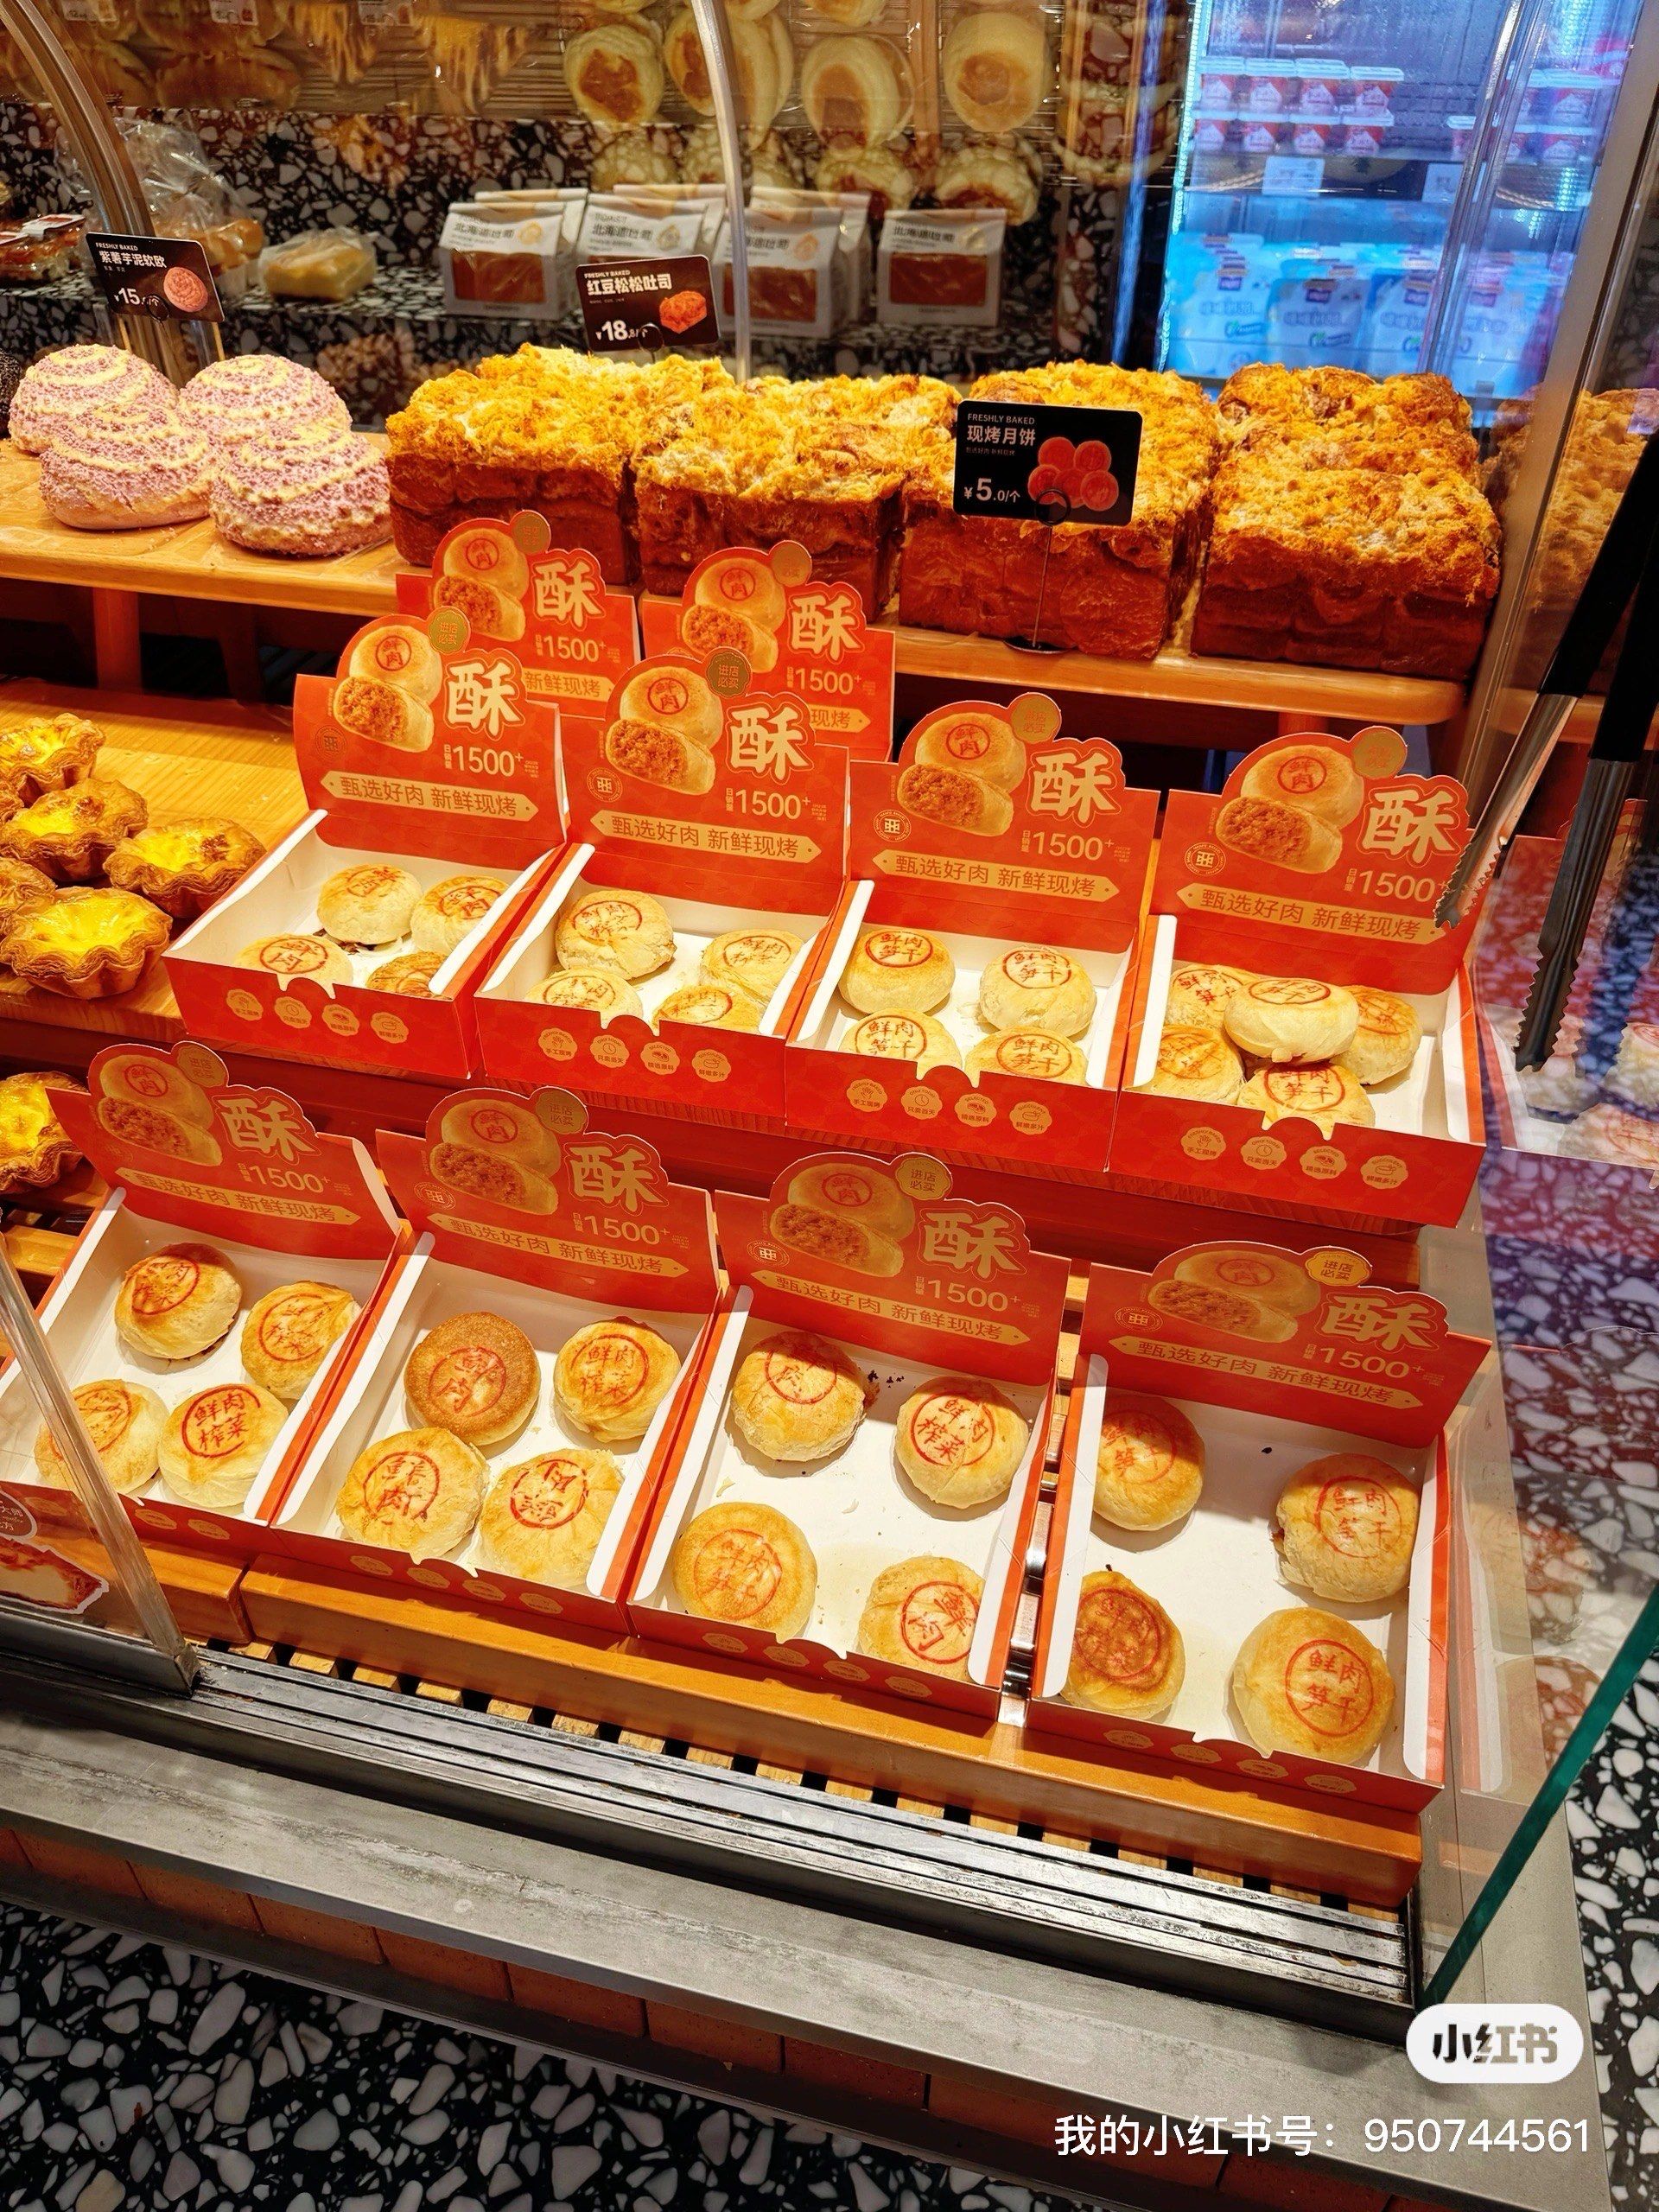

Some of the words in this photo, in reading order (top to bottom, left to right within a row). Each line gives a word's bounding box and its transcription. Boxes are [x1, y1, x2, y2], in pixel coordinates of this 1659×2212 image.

[99, 251, 167, 268] 紫薯芋泥软欧
[587, 273, 672, 296] 红豆松松吐司
[967, 425, 1036, 447] 现烤月饼
[968, 413, 1004, 423] FRESHLY
[1006, 416, 1035, 425] BAKED
[534, 561, 603, 627] 酥
[791, 594, 861, 661] 酥
[448, 661, 521, 736] 酥
[524, 671, 601, 697] 新鲜现烤
[730, 707, 809, 780] 酥
[340, 777, 424, 805] 甄选好肉
[431, 787, 517, 817] 新鲜现烤
[1031, 753, 1114, 823] 酥
[611, 816, 699, 846] 甄选好肉
[708, 829, 798, 859] 新鲜现烤
[1363, 790, 1455, 863] 酥
[895, 855, 988, 884] 甄选好肉
[998, 867, 1096, 897] 新鲜现烤
[1200, 888, 1303, 924] 甄选好肉
[1311, 907, 1421, 940] 新鲜现烤
[880, 932, 923, 949] 鲜肉
[880, 945, 922, 963] 笋干
[868, 1020, 914, 1039] 鲜肉
[1013, 1038, 1059, 1056] 鲜肉
[1013, 1053, 1060, 1072] 笋干
[218, 1098, 314, 1161] 酥
[569, 1146, 664, 1212] 酥
[910, 1180, 936, 1192] 必买
[911, 1169, 937, 1182] 进店
[133, 1173, 231, 1206] 甄选好肉
[236, 1194, 336, 1222] 新鲜现烤
[449, 1217, 550, 1254] 甄选好肉
[559, 1243, 664, 1274] 新鲜现烤
[921, 1212, 1024, 1278] 酥
[1324, 1260, 1354, 1273] 进店
[1320, 1268, 1351, 1281] 必买
[777, 1276, 880, 1313] 甄选好肉
[892, 1302, 1002, 1340] 新鲜现烤
[1322, 1295, 1433, 1351] 酥
[1136, 1340, 1257, 1376] 甄选好肉
[1267, 1365, 1394, 1404] 新鲜现烤
[194, 1393, 245, 1427] 鲜肉
[198, 1412, 249, 1452] 榨菜
[917, 1416, 965, 1464] 榨菜
[1307, 1649, 1363, 1694] 鲜肉
[1301, 1682, 1357, 1725] 笋干
